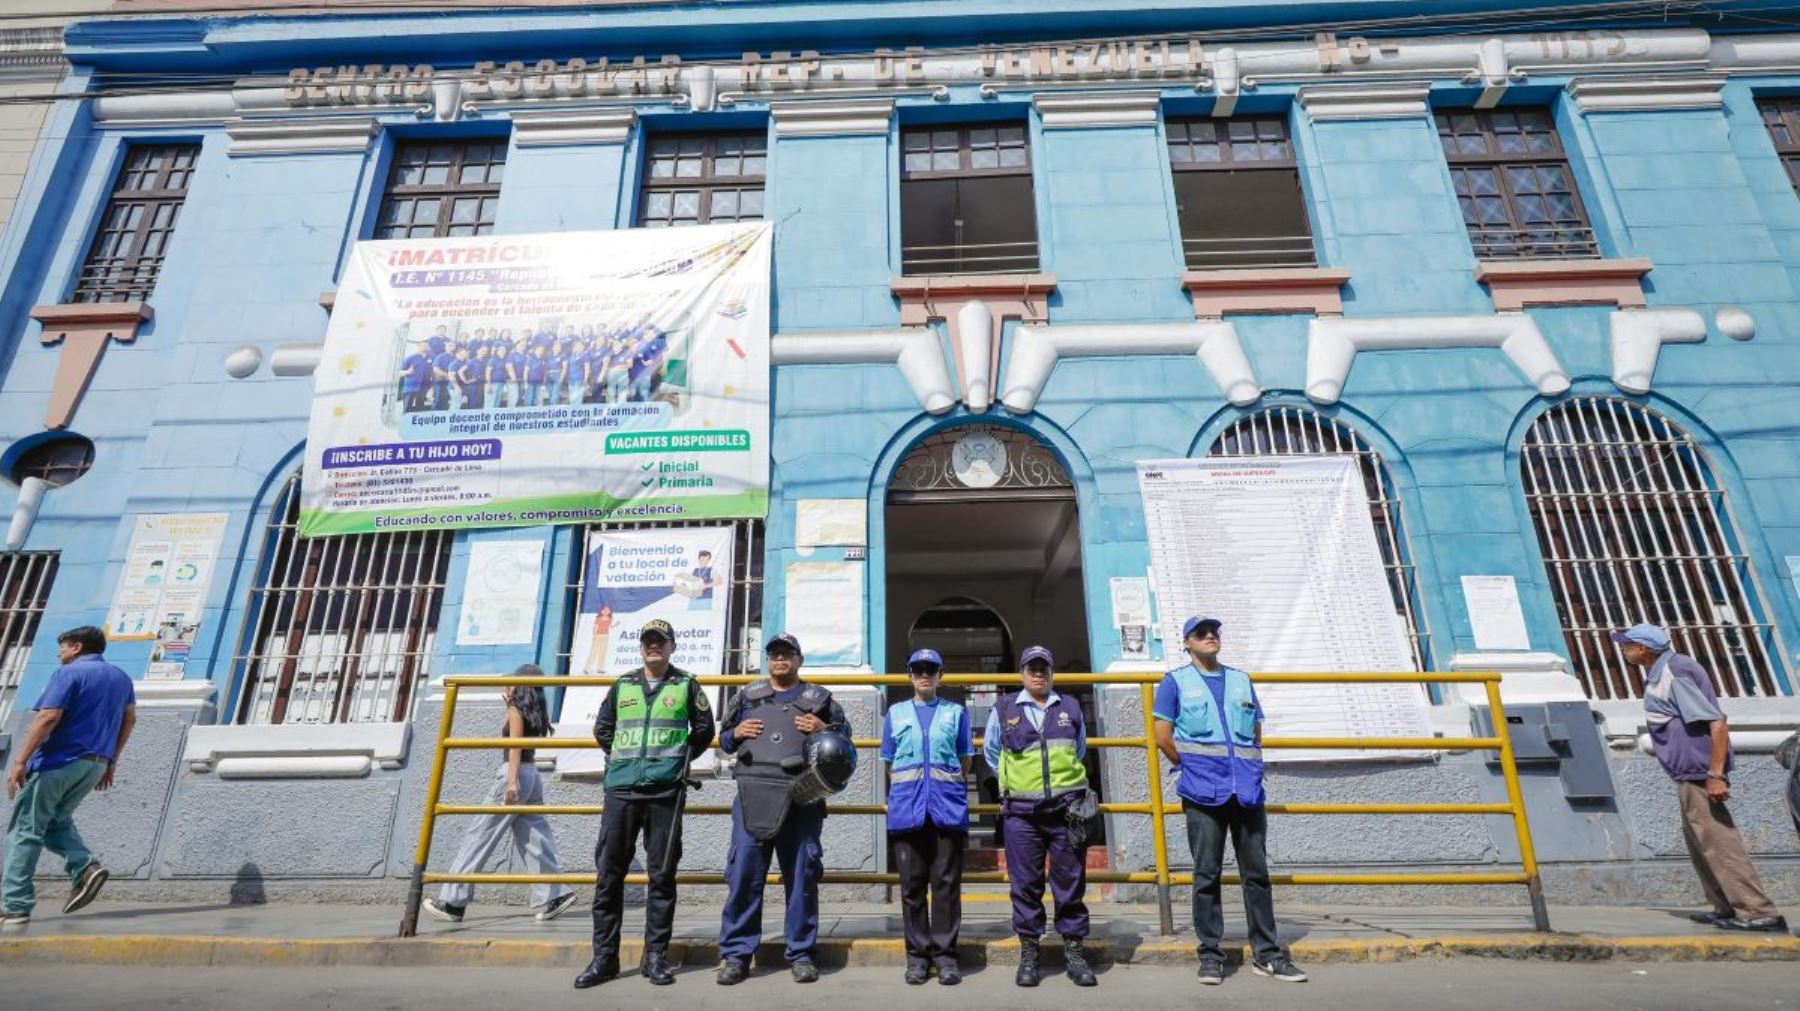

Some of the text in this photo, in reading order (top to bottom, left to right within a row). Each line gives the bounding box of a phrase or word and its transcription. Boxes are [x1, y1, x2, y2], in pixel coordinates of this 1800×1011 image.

[285, 63, 434, 98] CENTRO
[464, 54, 682, 97] ESCOLAR
[980, 39, 1208, 76] VENEZUELA
[448, 270, 486, 283] 1145
[408, 310, 438, 321] para
[442, 307, 498, 318] encender
[503, 305, 515, 316] el
[411, 415, 446, 427] Equipo
[449, 412, 491, 424] docente
[494, 407, 567, 424] comprometido
[571, 408, 590, 418] con
[449, 416, 619, 434] integral de nuestros estudiantes
[609, 434, 747, 450] VACANTES DISPONIBLES
[331, 443, 492, 464] ¡INSCRIBE A TU HIJO HOY!
[659, 461, 699, 472] Inicial
[659, 477, 713, 488] Primaria
[375, 504, 686, 527] Educando con valores, compromiso y excelencia.
[609, 545, 684, 557] Bienvenido
[608, 557, 688, 569] a tu local de
[606, 570, 665, 583] votación
[619, 628, 711, 640] Asi votar
